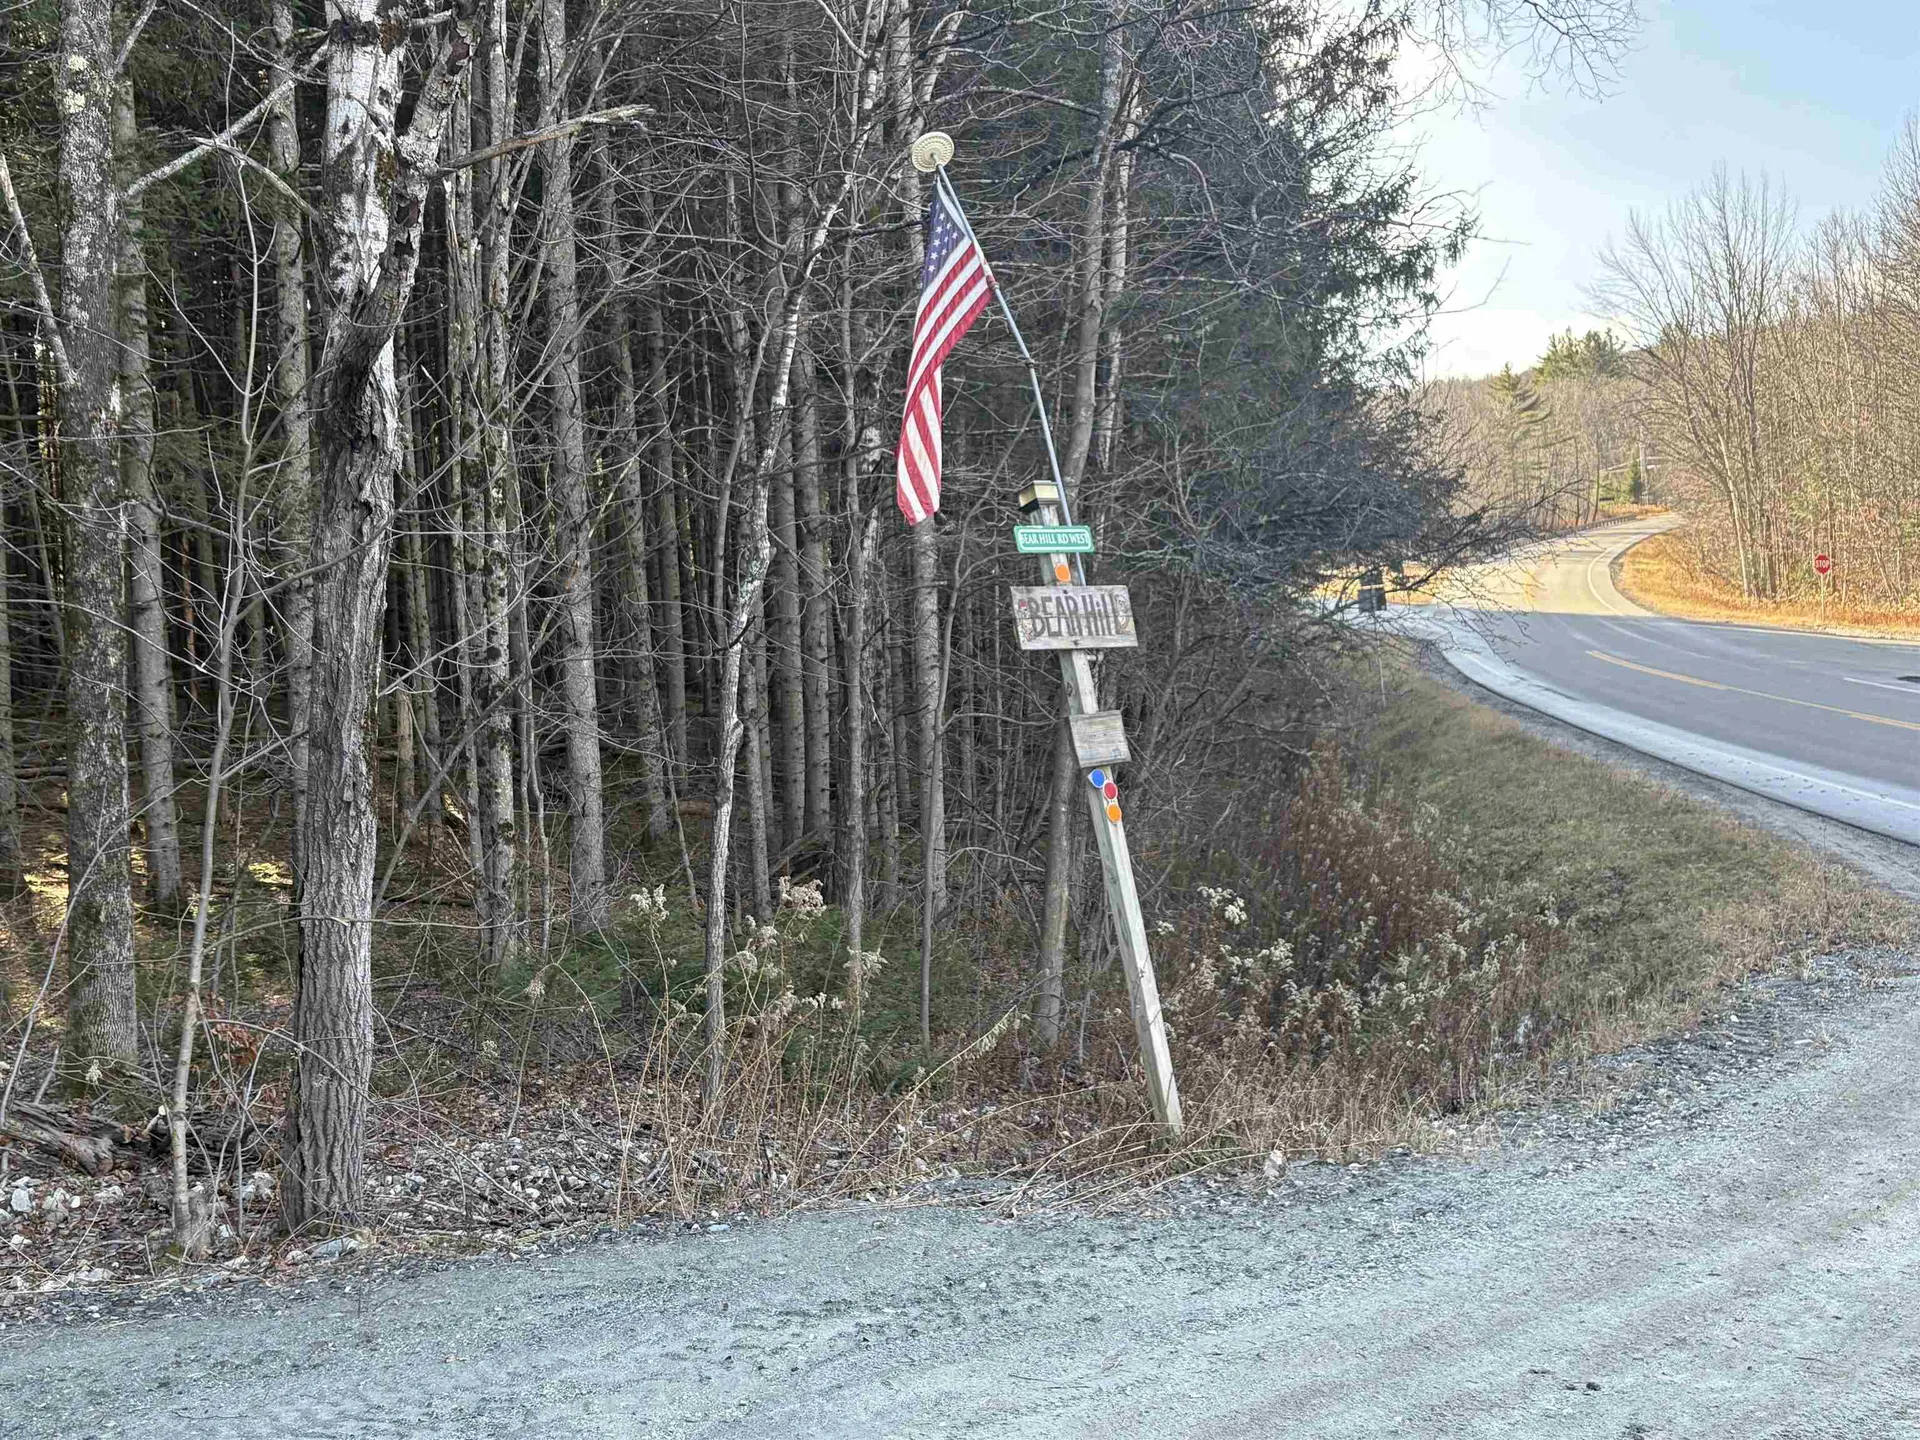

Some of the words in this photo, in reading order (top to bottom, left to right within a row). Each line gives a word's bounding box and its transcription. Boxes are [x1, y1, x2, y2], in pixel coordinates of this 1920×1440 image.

[1039, 533, 1056, 544] HILL
[1057, 533, 1068, 544] RD
[1815, 559, 1829, 568] STOP
[1027, 596, 1083, 638] BEAR
